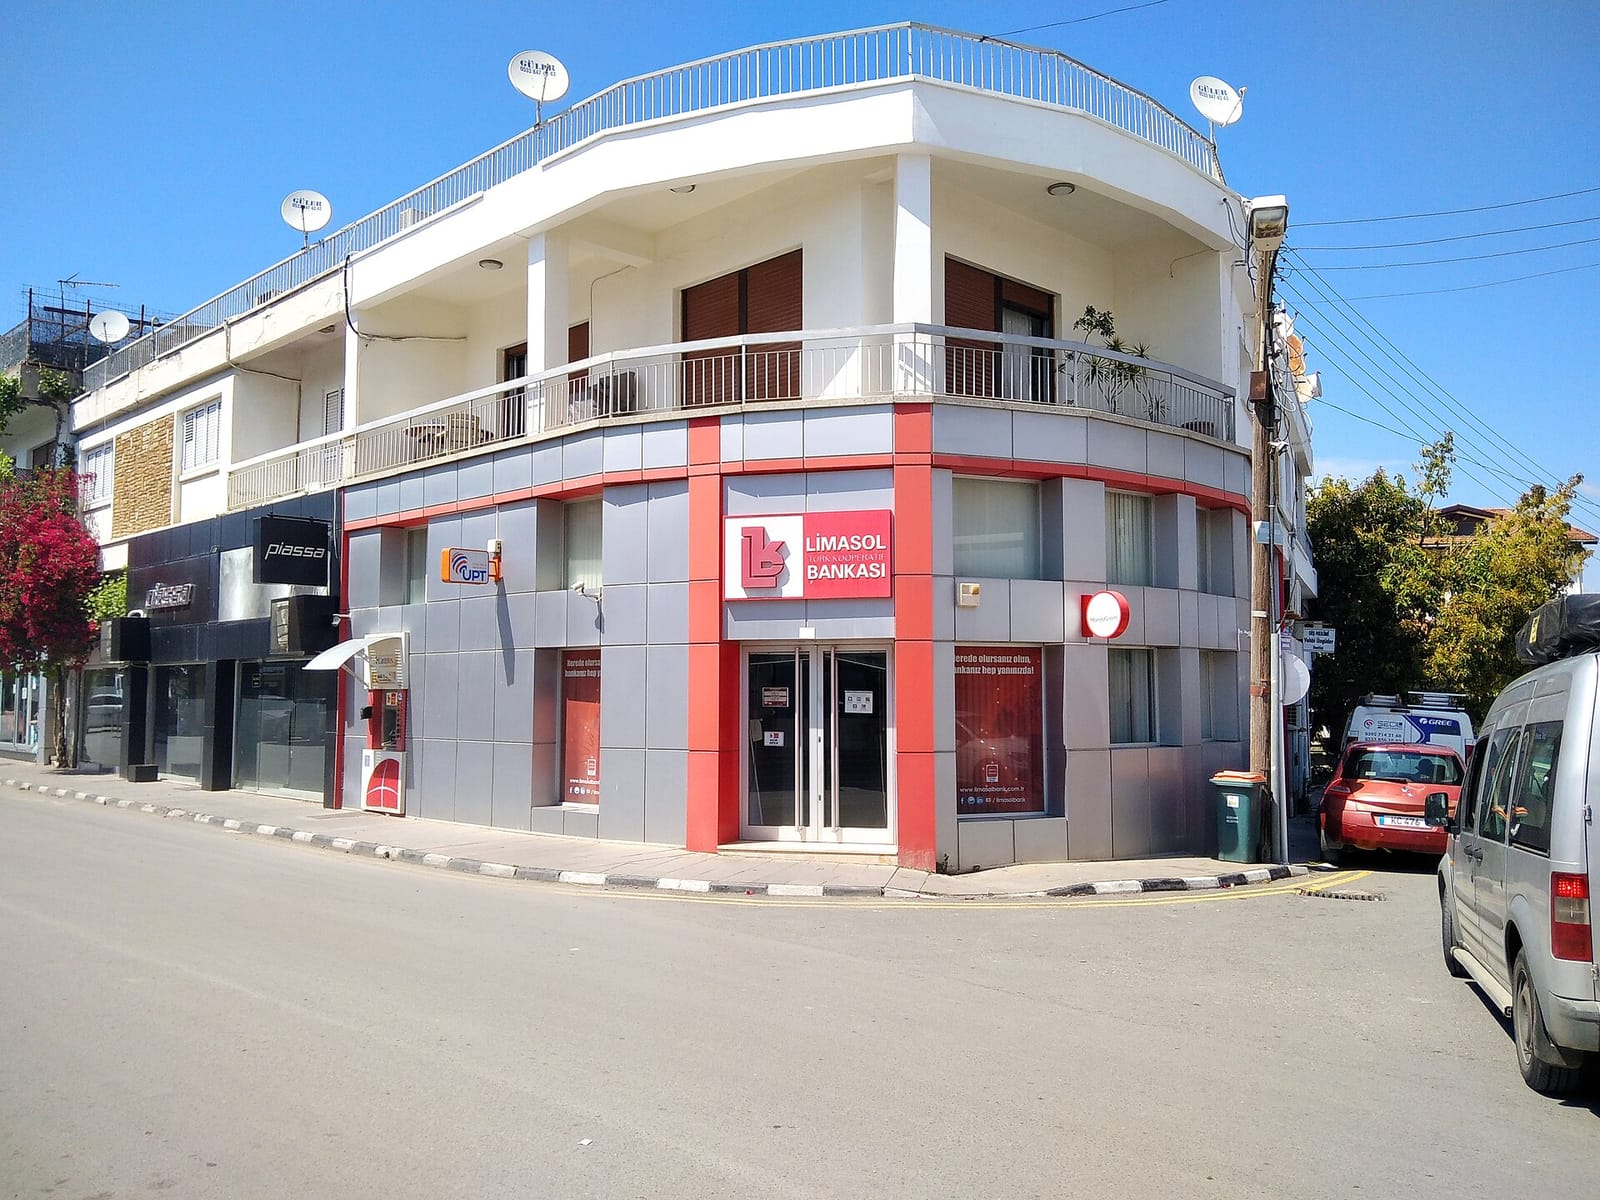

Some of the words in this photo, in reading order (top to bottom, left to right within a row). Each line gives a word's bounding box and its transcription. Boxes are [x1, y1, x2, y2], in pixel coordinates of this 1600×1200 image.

[806, 533, 887, 552] LİMASOL
[264, 542, 325, 560] piassa
[462, 569, 487, 581] UPT
[808, 563, 886, 580] BANKASI
[978, 654, 1012, 663] olursanız
[982, 666, 996, 675] hep
